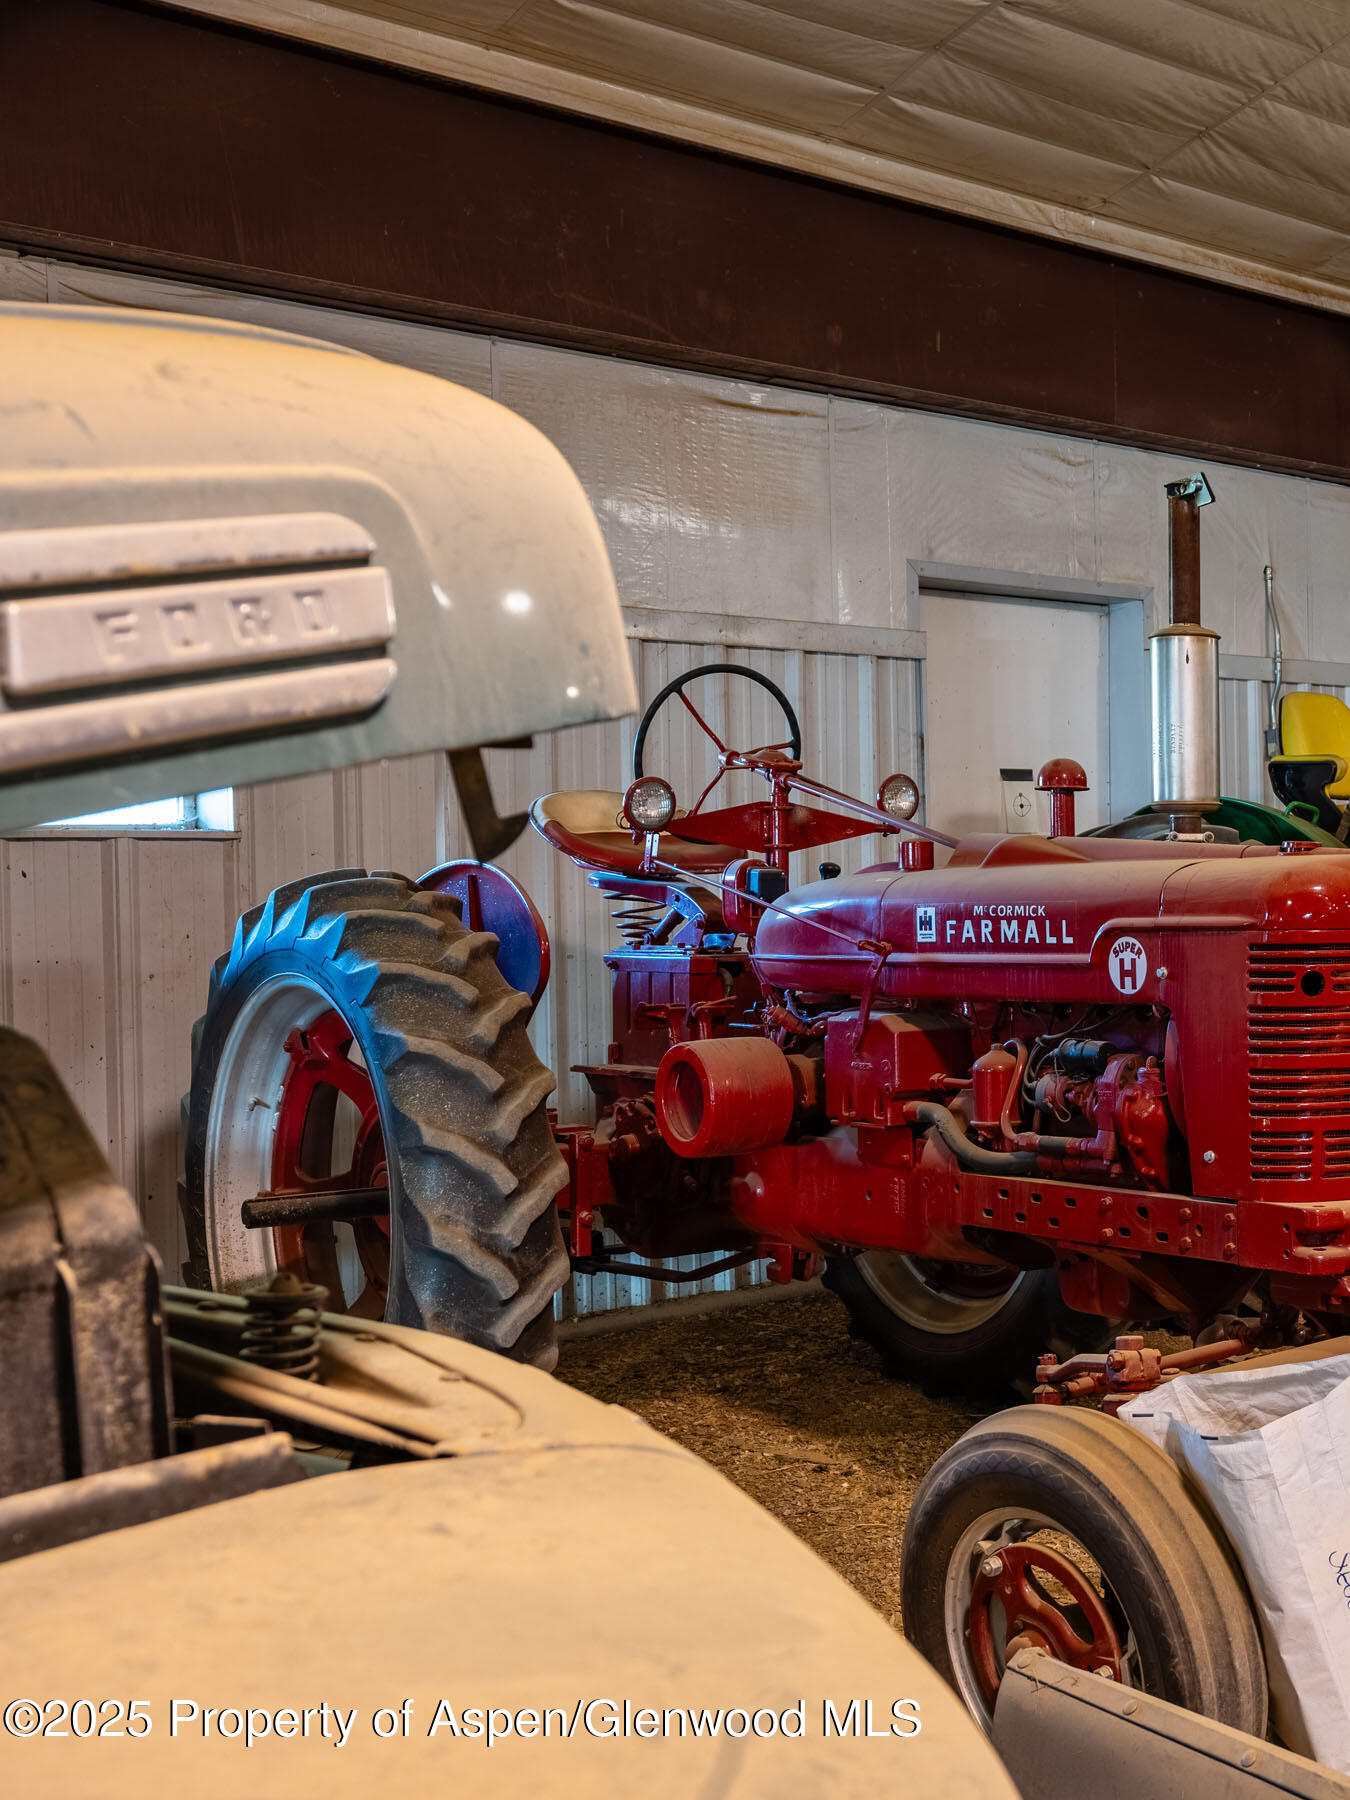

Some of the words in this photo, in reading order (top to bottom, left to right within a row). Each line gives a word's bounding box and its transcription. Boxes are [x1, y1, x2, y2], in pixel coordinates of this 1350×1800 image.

[93, 589, 340, 665] FORD
[946, 919, 1074, 944] FARMALL
[1112, 941, 1143, 959] SUPER
[1119, 958, 1137, 990] H
